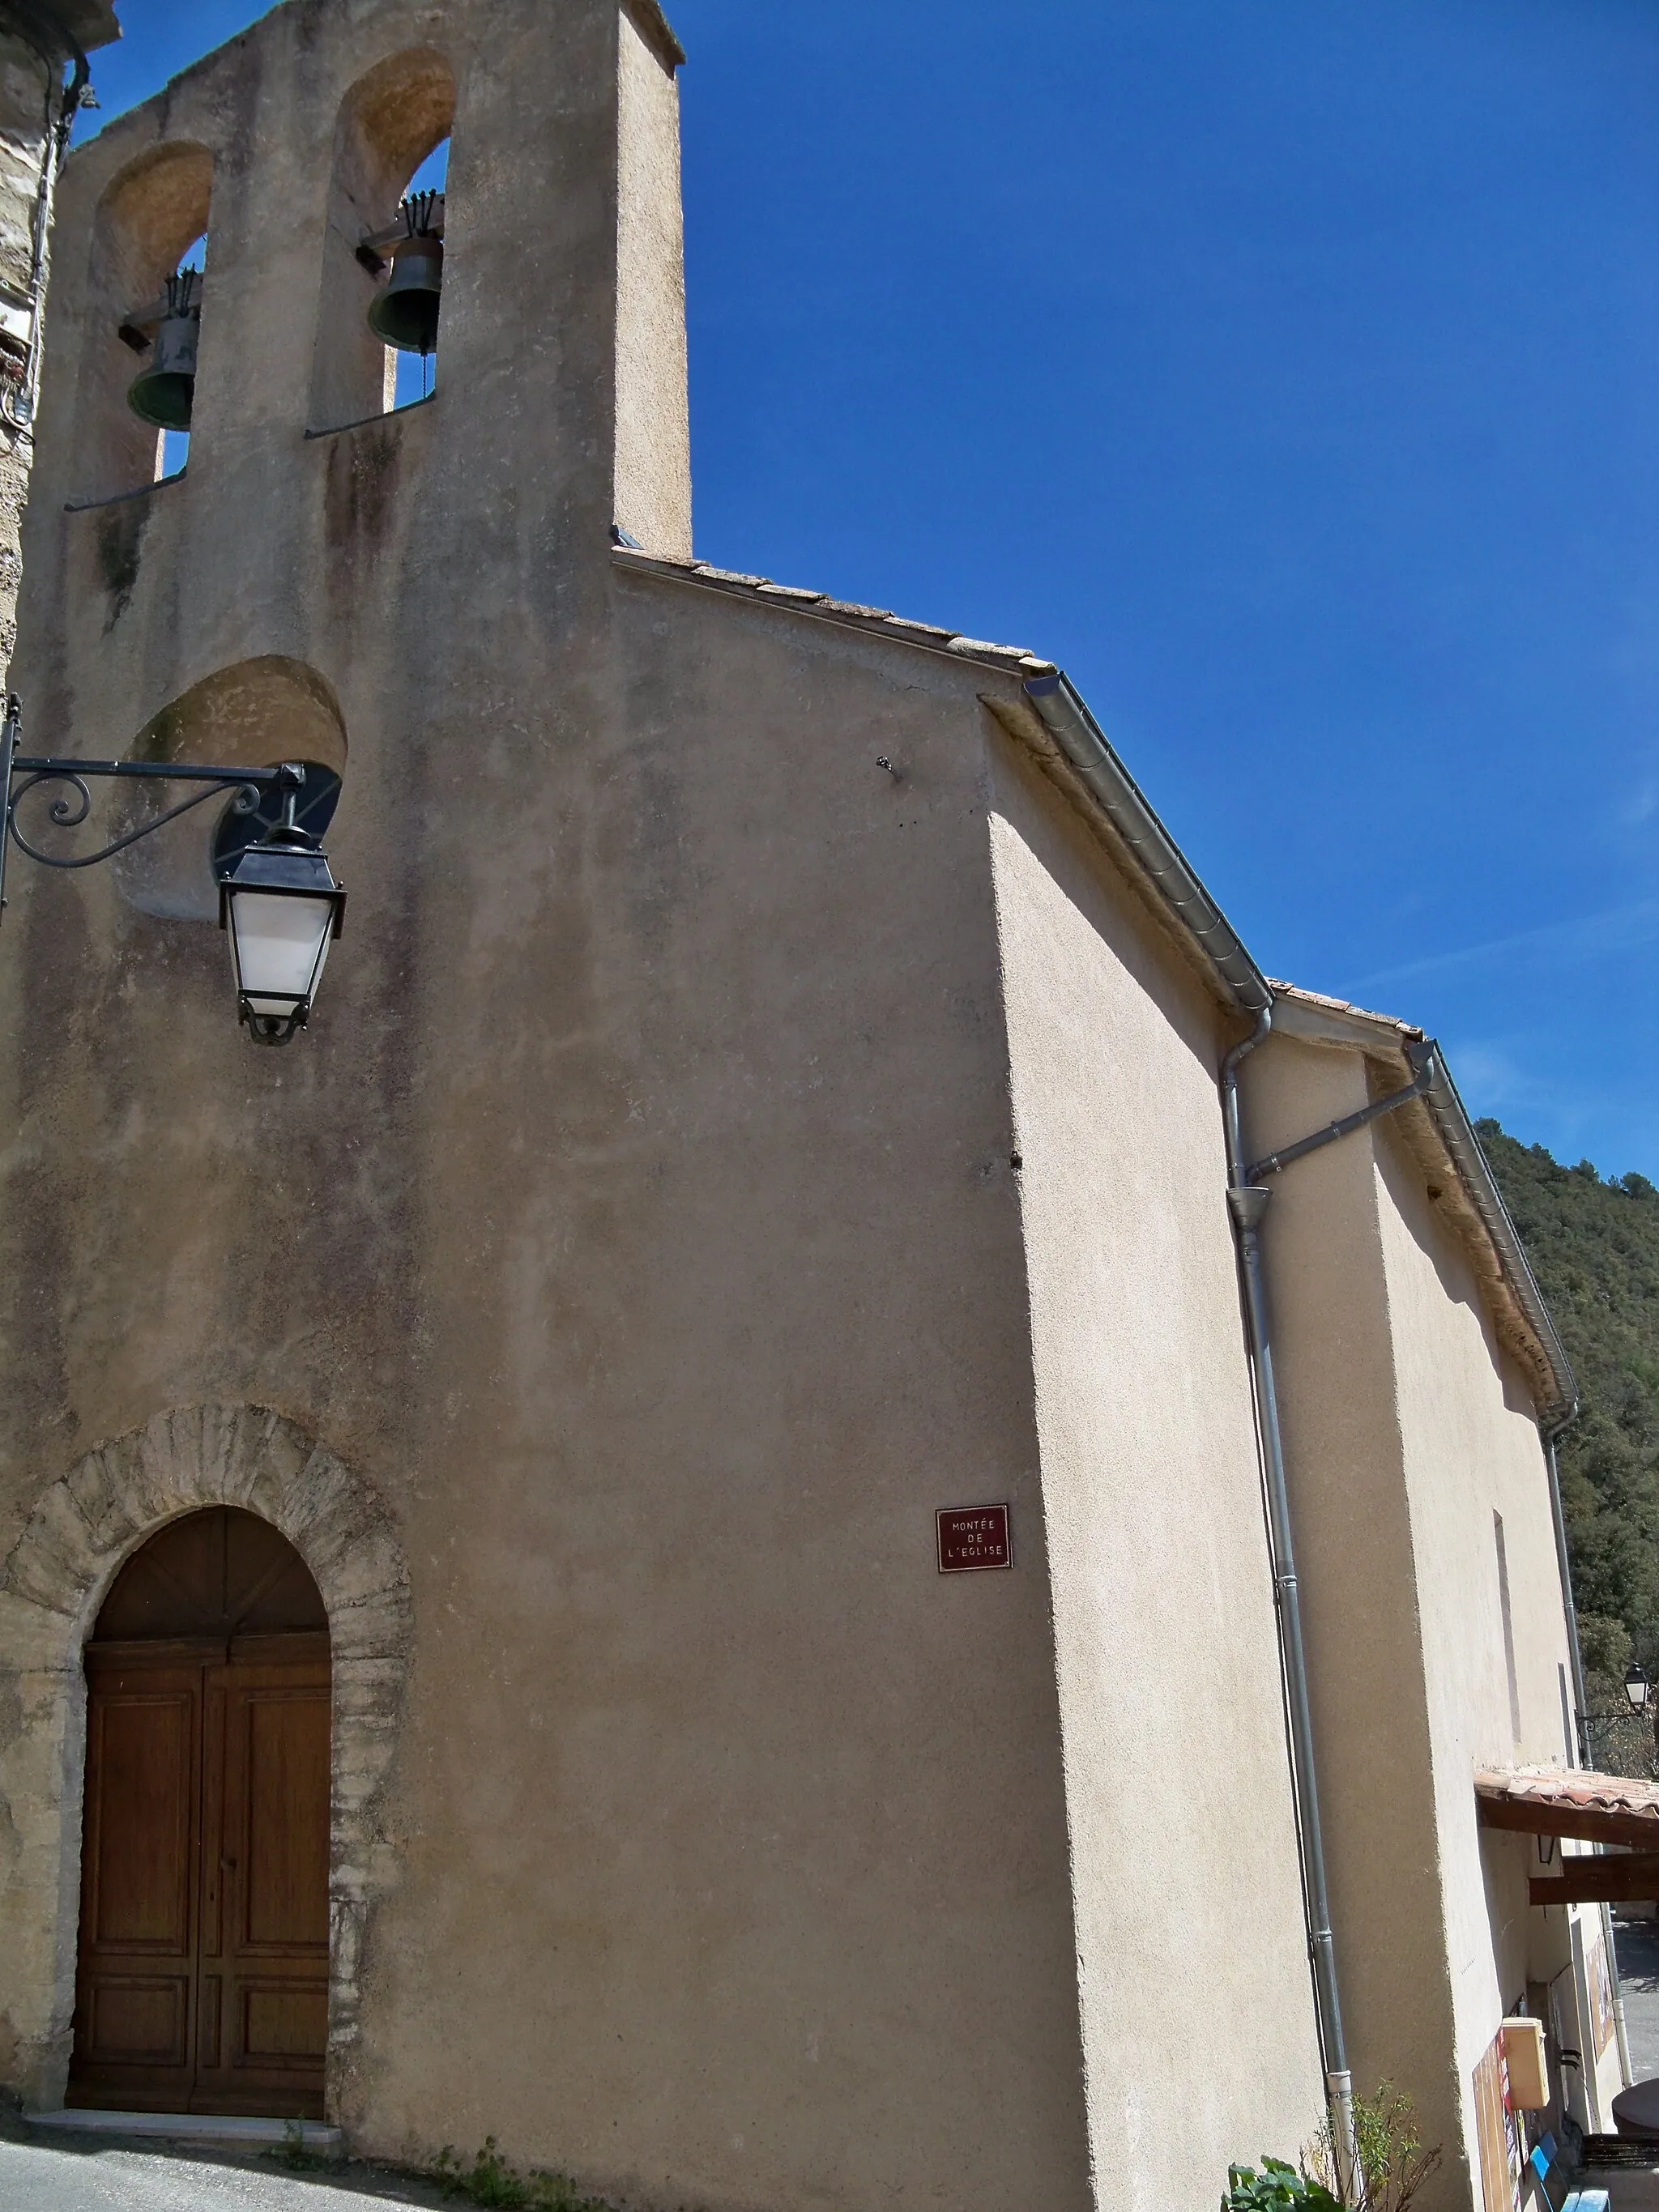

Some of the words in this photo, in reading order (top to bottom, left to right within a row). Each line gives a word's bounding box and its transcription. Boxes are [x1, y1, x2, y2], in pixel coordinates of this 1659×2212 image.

[953, 1517, 995, 1531] MONTÉE
[967, 1533, 983, 1543] DE
[948, 1545, 1002, 1558] L'EGLISE
